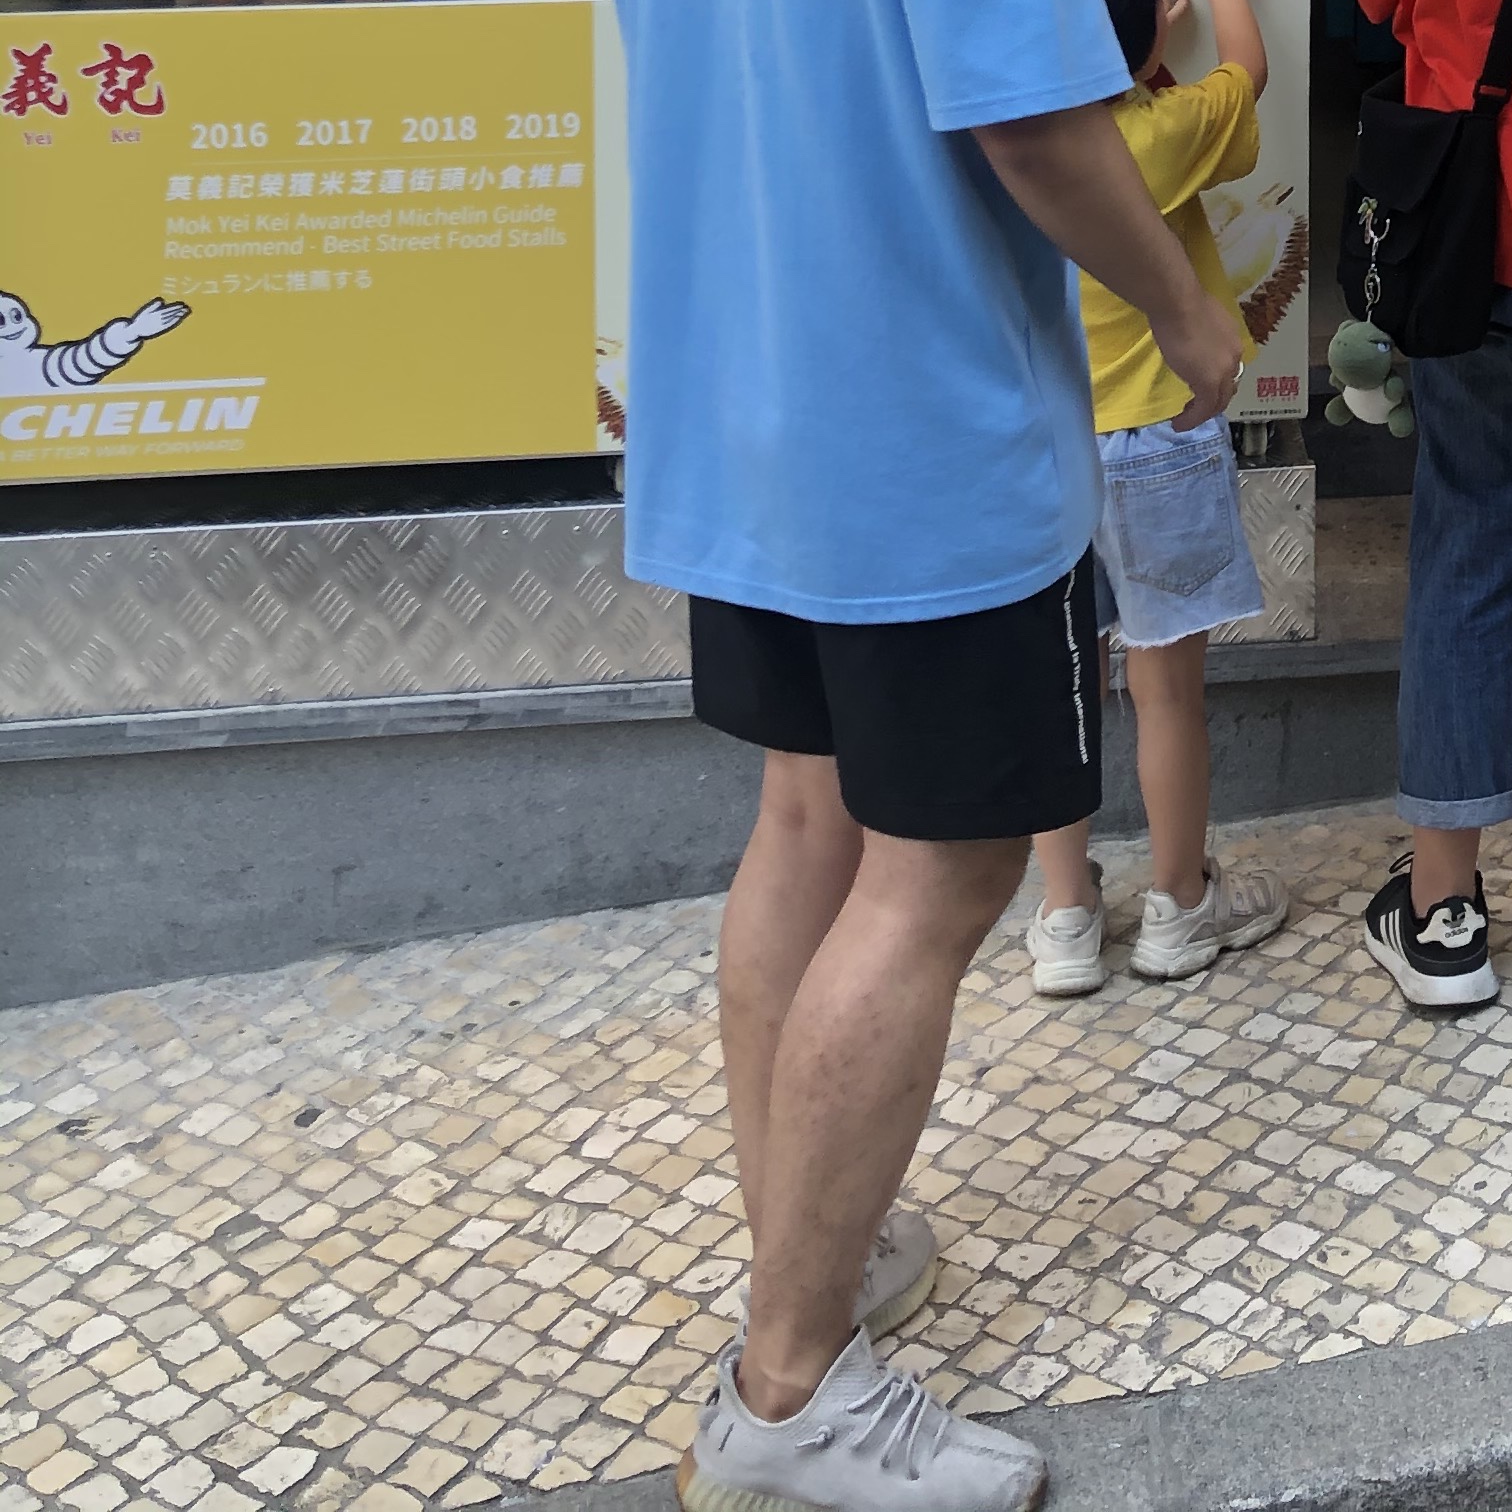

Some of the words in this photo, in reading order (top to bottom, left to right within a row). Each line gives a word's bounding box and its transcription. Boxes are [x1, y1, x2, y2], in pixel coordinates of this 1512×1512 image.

[0, 42, 166, 117] 義記
[23, 131, 53, 145] Yei
[110, 128, 142, 144] Kei
[191, 121, 269, 150] 2016
[295, 118, 373, 147] 2017
[401, 115, 478, 144] 2018
[505, 112, 581, 140] 2019
[166, 216, 213, 236] Mok
[218, 213, 250, 233] Yei
[255, 212, 290, 232] Kei
[295, 209, 392, 231] Awarded
[399, 205, 488, 229] Michelin
[493, 202, 557, 225] Guide
[164, 236, 305, 260] Recommend
[322, 234, 371, 254] Best
[376, 231, 442, 252] Street
[447, 228, 502, 249] Food
[507, 226, 568, 248] Stalls
[96, 442, 139, 459] WAY
